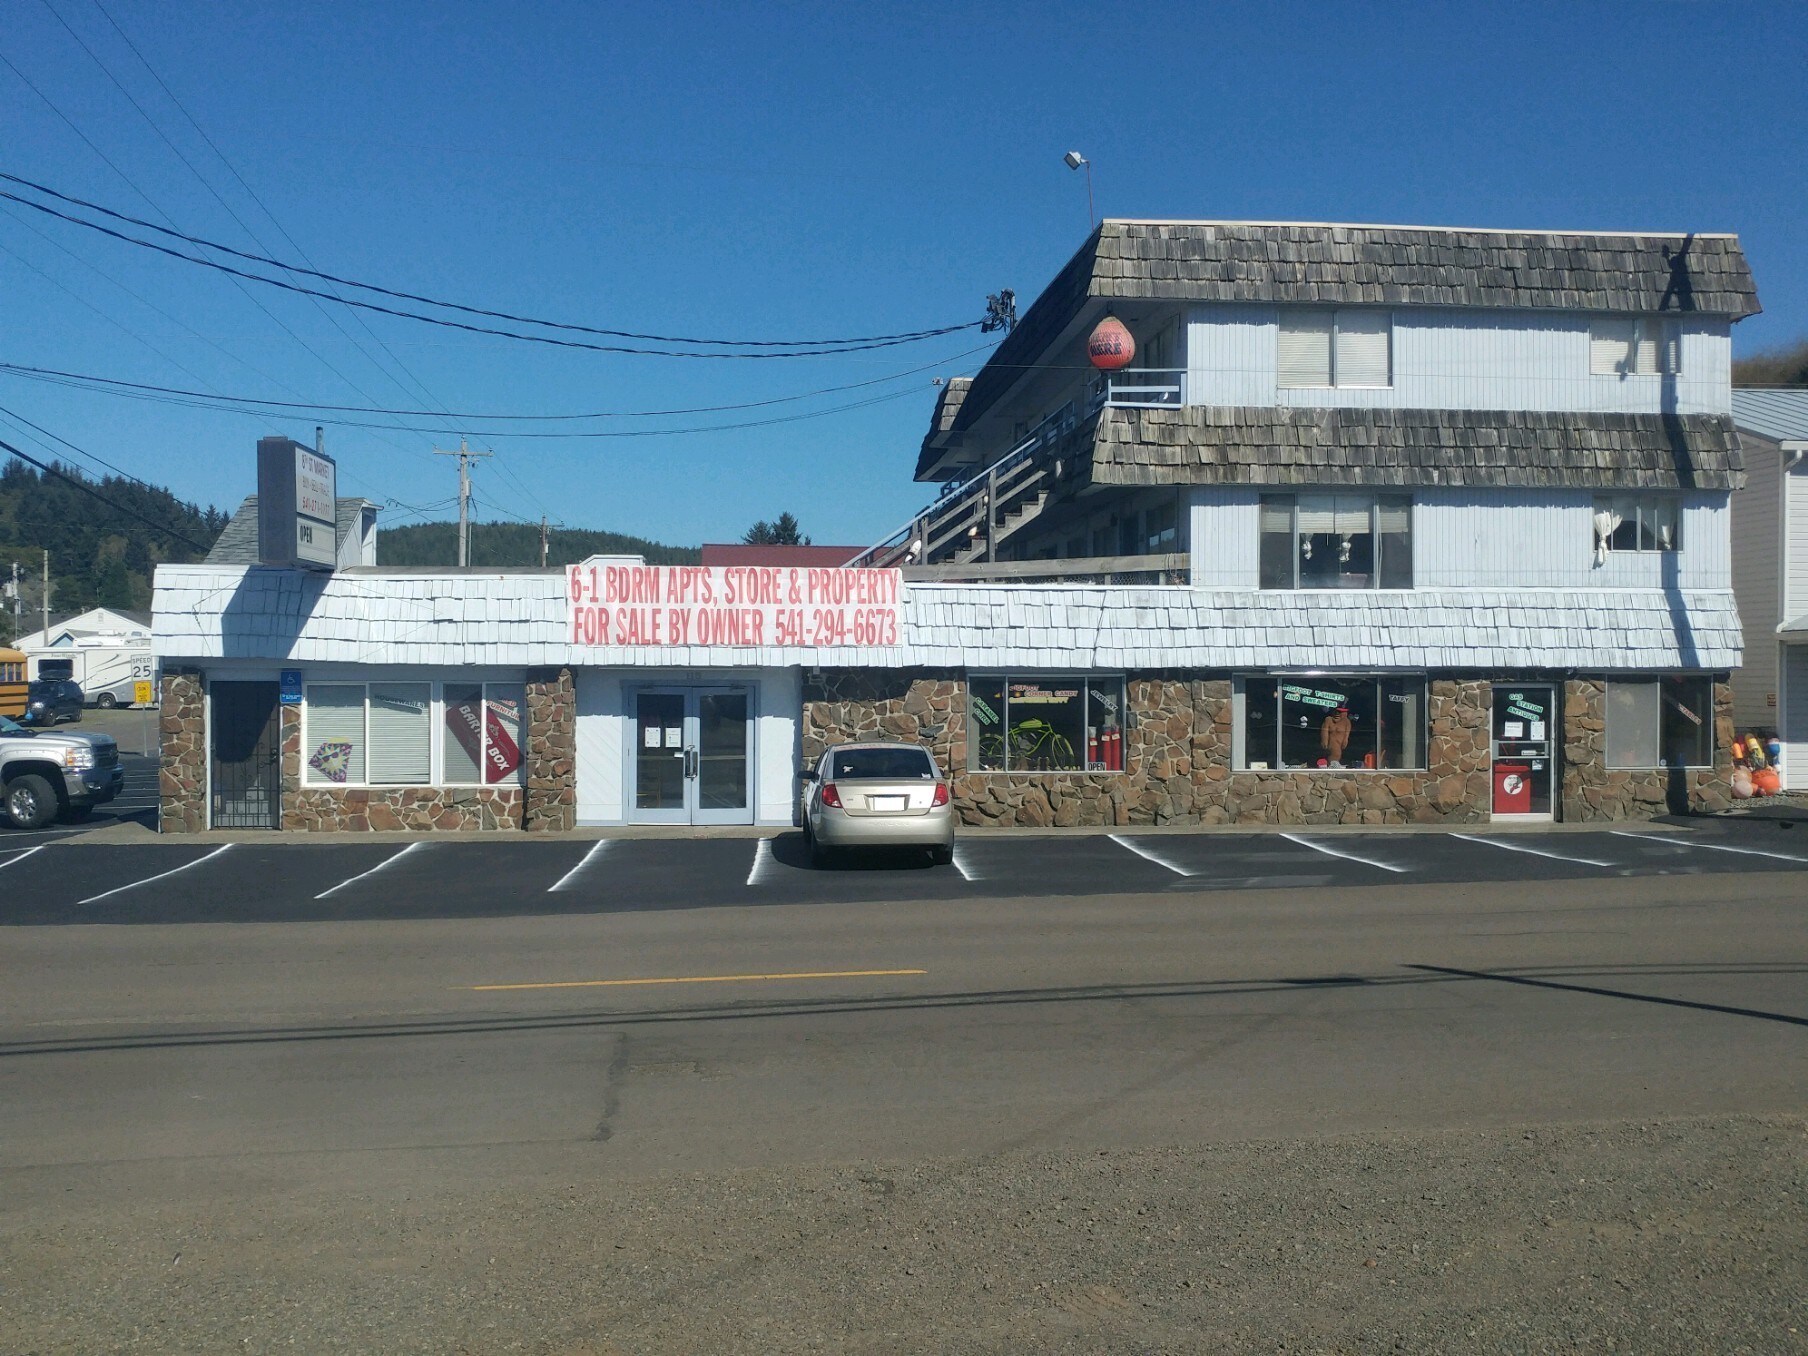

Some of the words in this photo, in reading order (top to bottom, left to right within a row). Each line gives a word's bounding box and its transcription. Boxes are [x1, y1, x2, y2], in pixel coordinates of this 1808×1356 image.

[300, 524, 313, 544] OPEN
[571, 566, 599, 603] 6-1
[606, 566, 660, 603] BDRM
[667, 567, 718, 607] APTS,
[724, 567, 782, 604] STORE
[788, 568, 802, 604] &
[808, 568, 899, 605] PROPERTY
[574, 606, 610, 645] FOR
[616, 607, 662, 645] SALE
[669, 608, 691, 645] BY
[697, 608, 763, 645] OWNER
[775, 608, 896, 645] 541-294-6673
[133, 665, 151, 678] 25
[1282, 684, 1312, 696] BIGFOOT
[1388, 694, 1410, 703] TAFFY
[1509, 693, 1523, 701] GAS
[1090, 689, 1118, 712] JEWELRY
[1285, 692, 1301, 702] AND
[1302, 696, 1338, 708] SWEATERS
[1516, 700, 1543, 714] STATION
[487, 700, 521, 722] FURNITUR
[974, 696, 1000, 724] CARAMEL
[974, 708, 991, 726] CORN
[1507, 706, 1540, 721] ANTIQUES
[459, 705, 493, 746] BARR
[487, 747, 510, 771] BOX
[1088, 762, 1105, 772] OPEN
